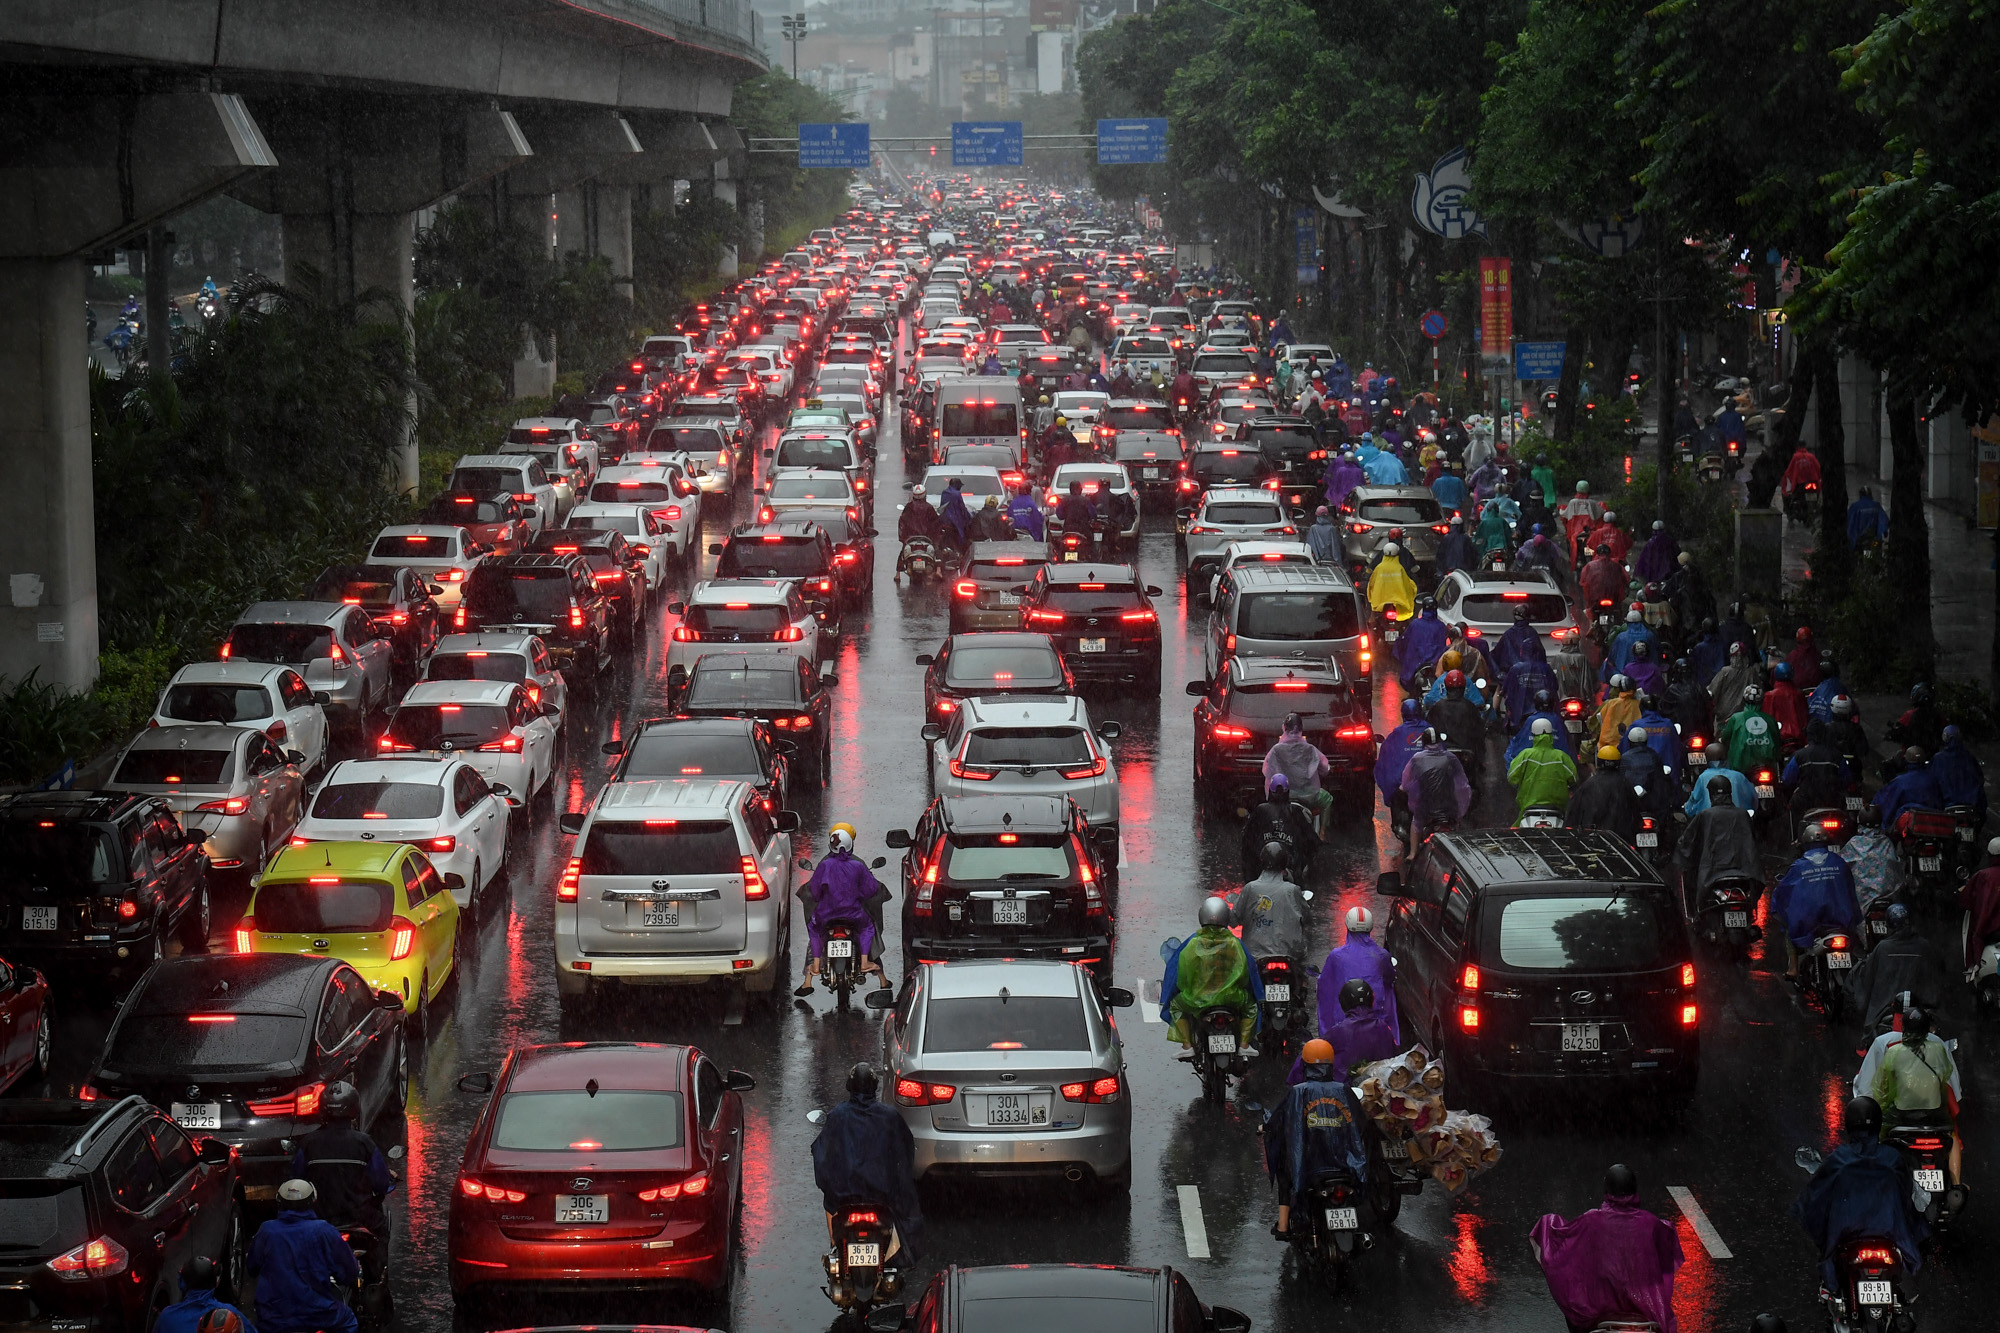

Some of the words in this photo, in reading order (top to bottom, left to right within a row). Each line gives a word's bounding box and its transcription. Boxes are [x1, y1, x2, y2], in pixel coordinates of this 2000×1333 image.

[1746, 737, 1770, 746] Grab
[651, 902, 670, 913] 30F
[1000, 901, 1019, 911] 29A
[31, 908, 49, 918] 30A
[994, 913, 1026, 923] 039.38
[24, 918, 56, 929] 615.19
[645, 914, 678, 925] 739.56
[1829, 960, 1851, 968] 452.35
[1571, 1026, 1590, 1037] 51F
[1212, 1036, 1231, 1044] 34-F1
[1563, 1038, 1599, 1050] 842.50
[1210, 1044, 1234, 1052] 055.75
[996, 1095, 1019, 1109] 30A
[186, 1105, 206, 1115] 30G
[990, 1110, 1028, 1123] 133.34
[176, 1117, 215, 1127] 530.26
[1917, 1171, 1939, 1180] 99-F1
[1918, 1180, 1942, 1190] 42.61
[570, 1197, 593, 1208] 30G
[561, 1209, 602, 1221] 755.17
[1330, 1209, 1351, 1219] 29-X7
[1329, 1219, 1356, 1229] 058.16
[852, 1245, 874, 1254] 36-B7
[849, 1255, 877, 1265] 029.28
[1863, 1283, 1886, 1292] 89-B1
[1860, 1293, 1891, 1302] 701.23
